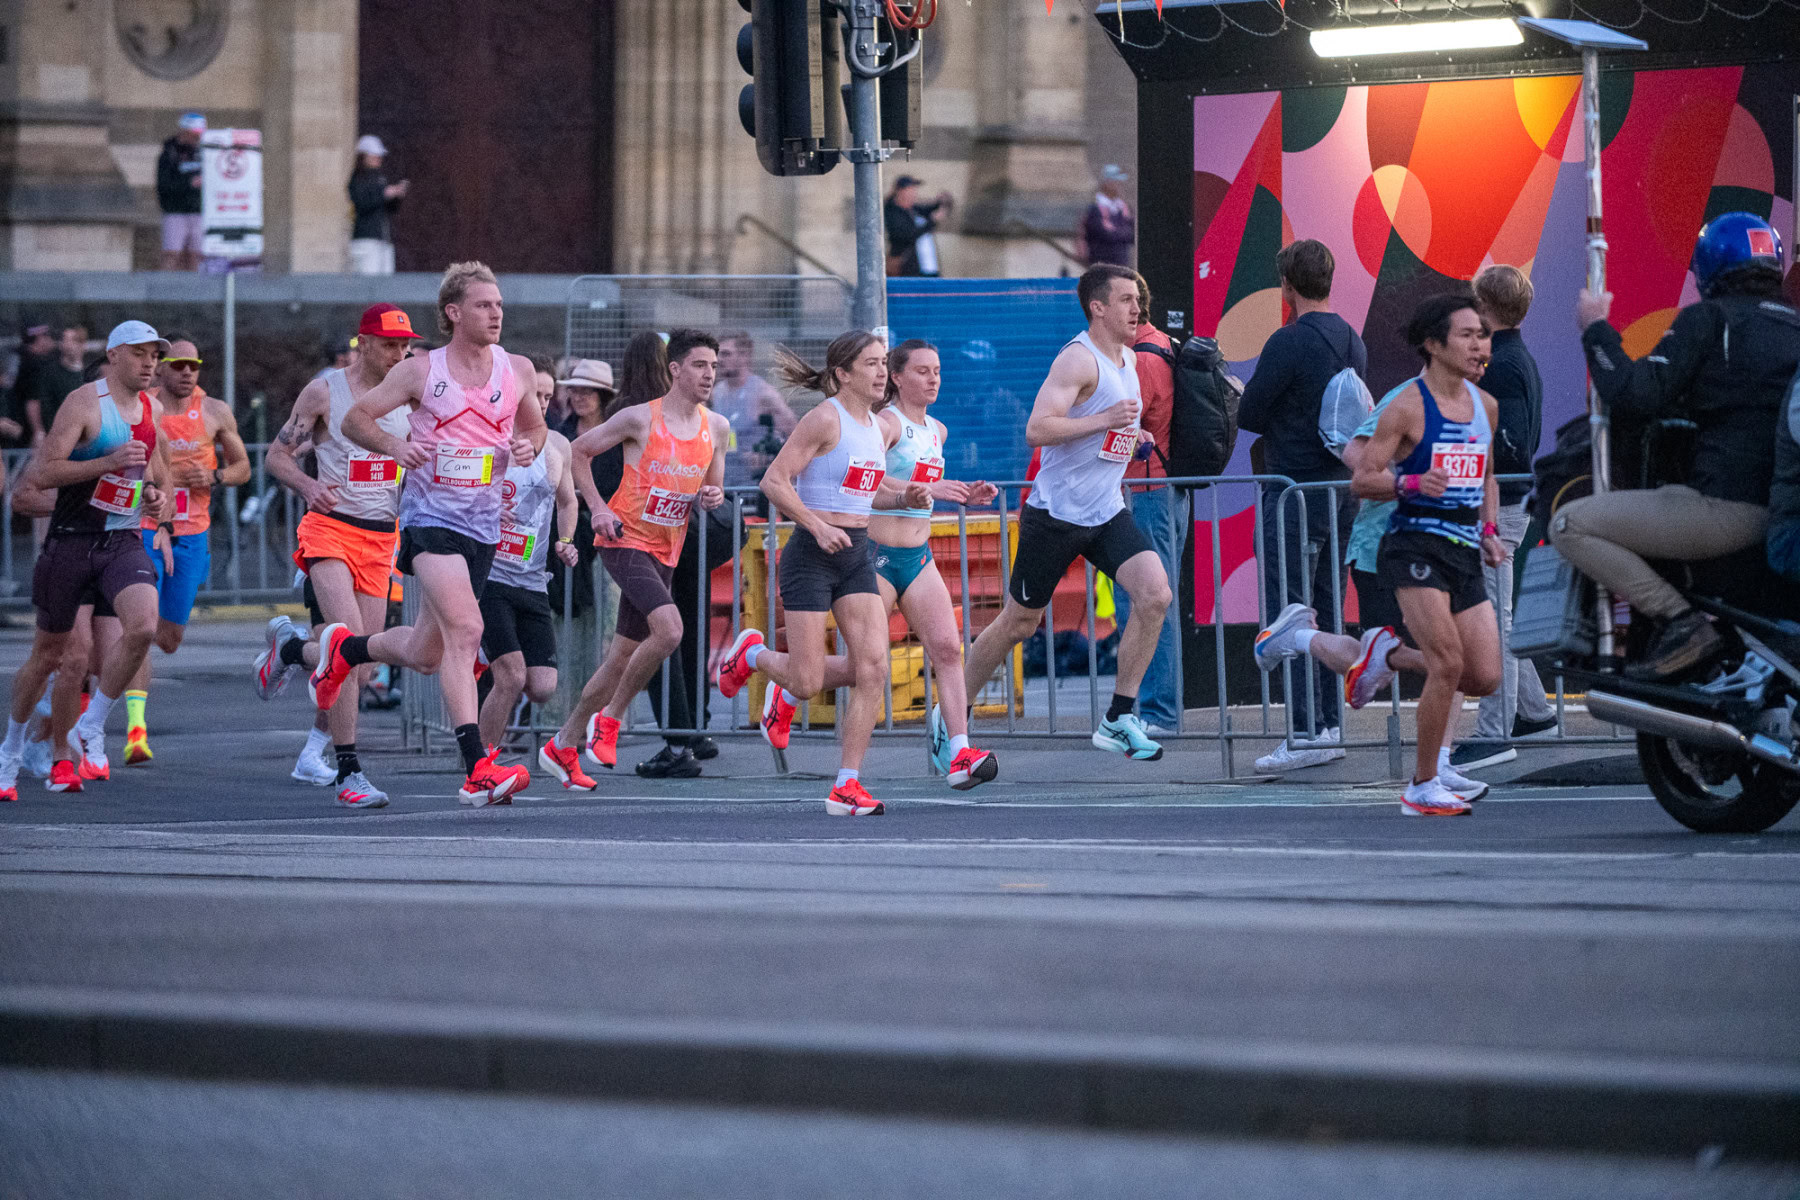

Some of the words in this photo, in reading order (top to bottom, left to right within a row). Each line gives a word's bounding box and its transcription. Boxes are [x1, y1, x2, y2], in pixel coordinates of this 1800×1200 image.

[370, 462, 384, 472] JACK
[442, 459, 471, 472] Cam
[648, 460, 706, 478] RUNASON
[1442, 454, 1478, 477] 9376
[859, 470, 876, 490] 50
[654, 499, 688, 519] 5423
[499, 532, 525, 546] KOUMIS
[500, 542, 511, 552] 34
